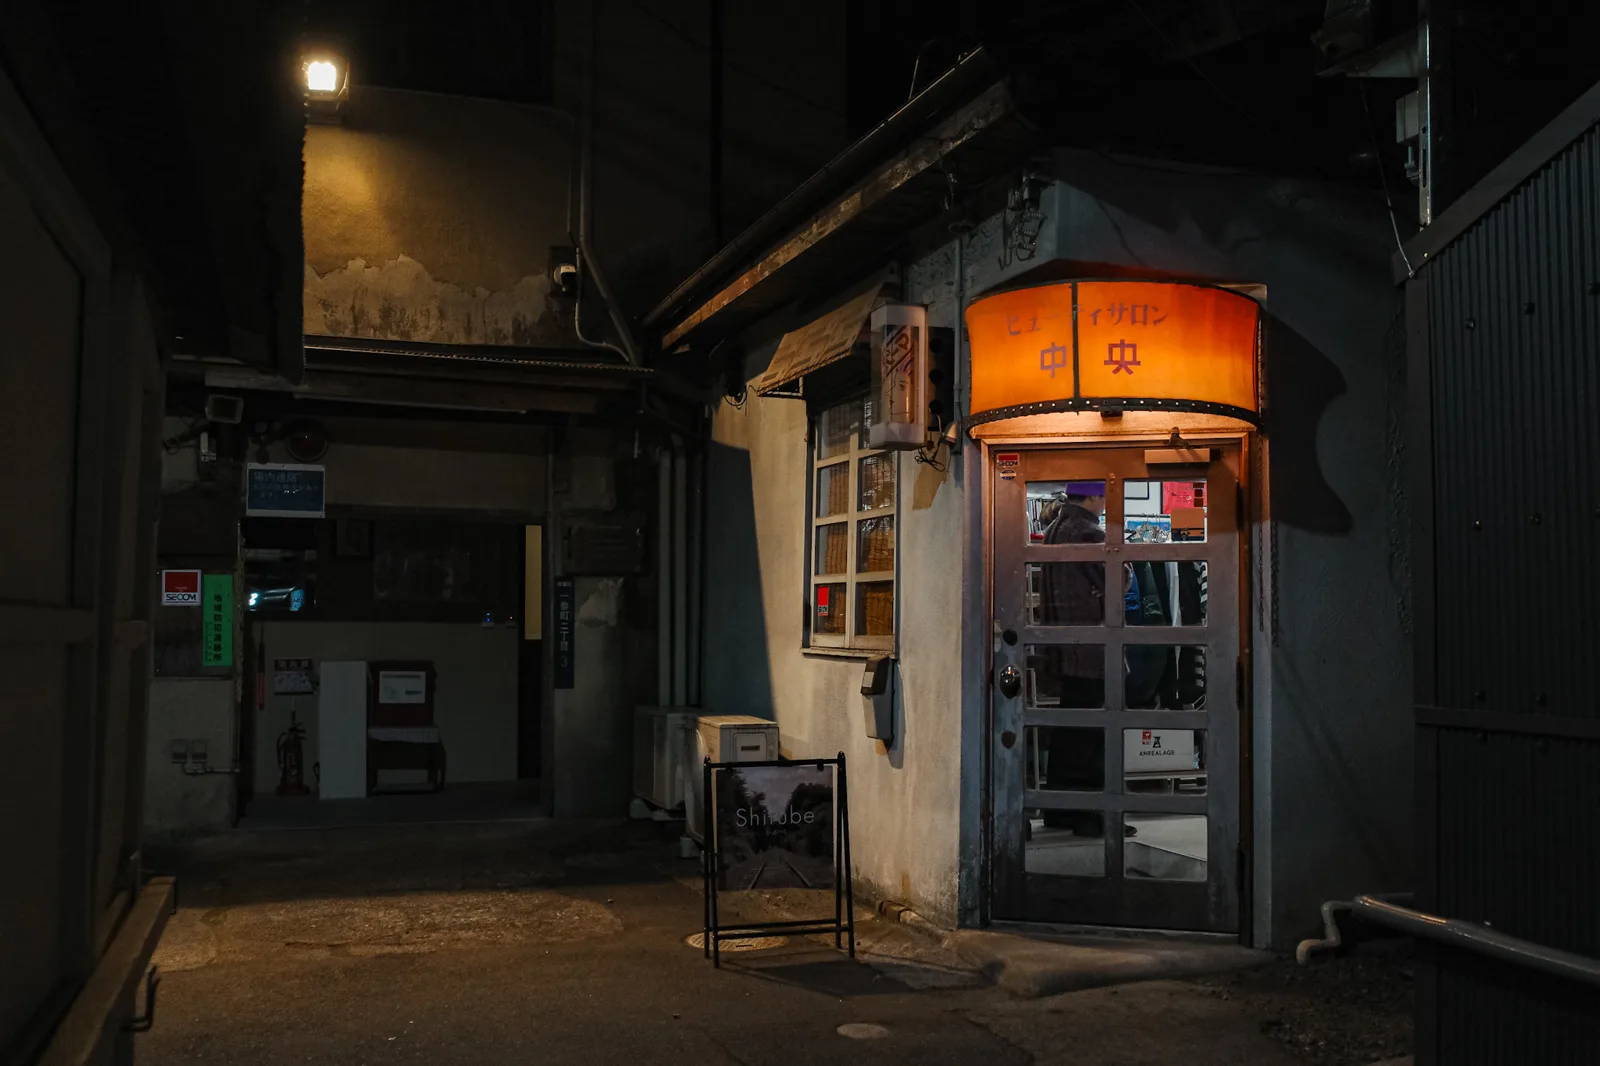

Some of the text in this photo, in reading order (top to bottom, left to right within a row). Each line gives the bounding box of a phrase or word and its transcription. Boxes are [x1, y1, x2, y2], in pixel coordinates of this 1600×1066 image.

[1040, 339, 1141, 379] 中央
[166, 593, 197, 601] SECOM
[213, 594, 223, 661] 地域防犯連絡所
[560, 655, 568, 668] 3
[1138, 749, 1176, 757] ANREALAGE
[736, 804, 815, 827] Shirube
